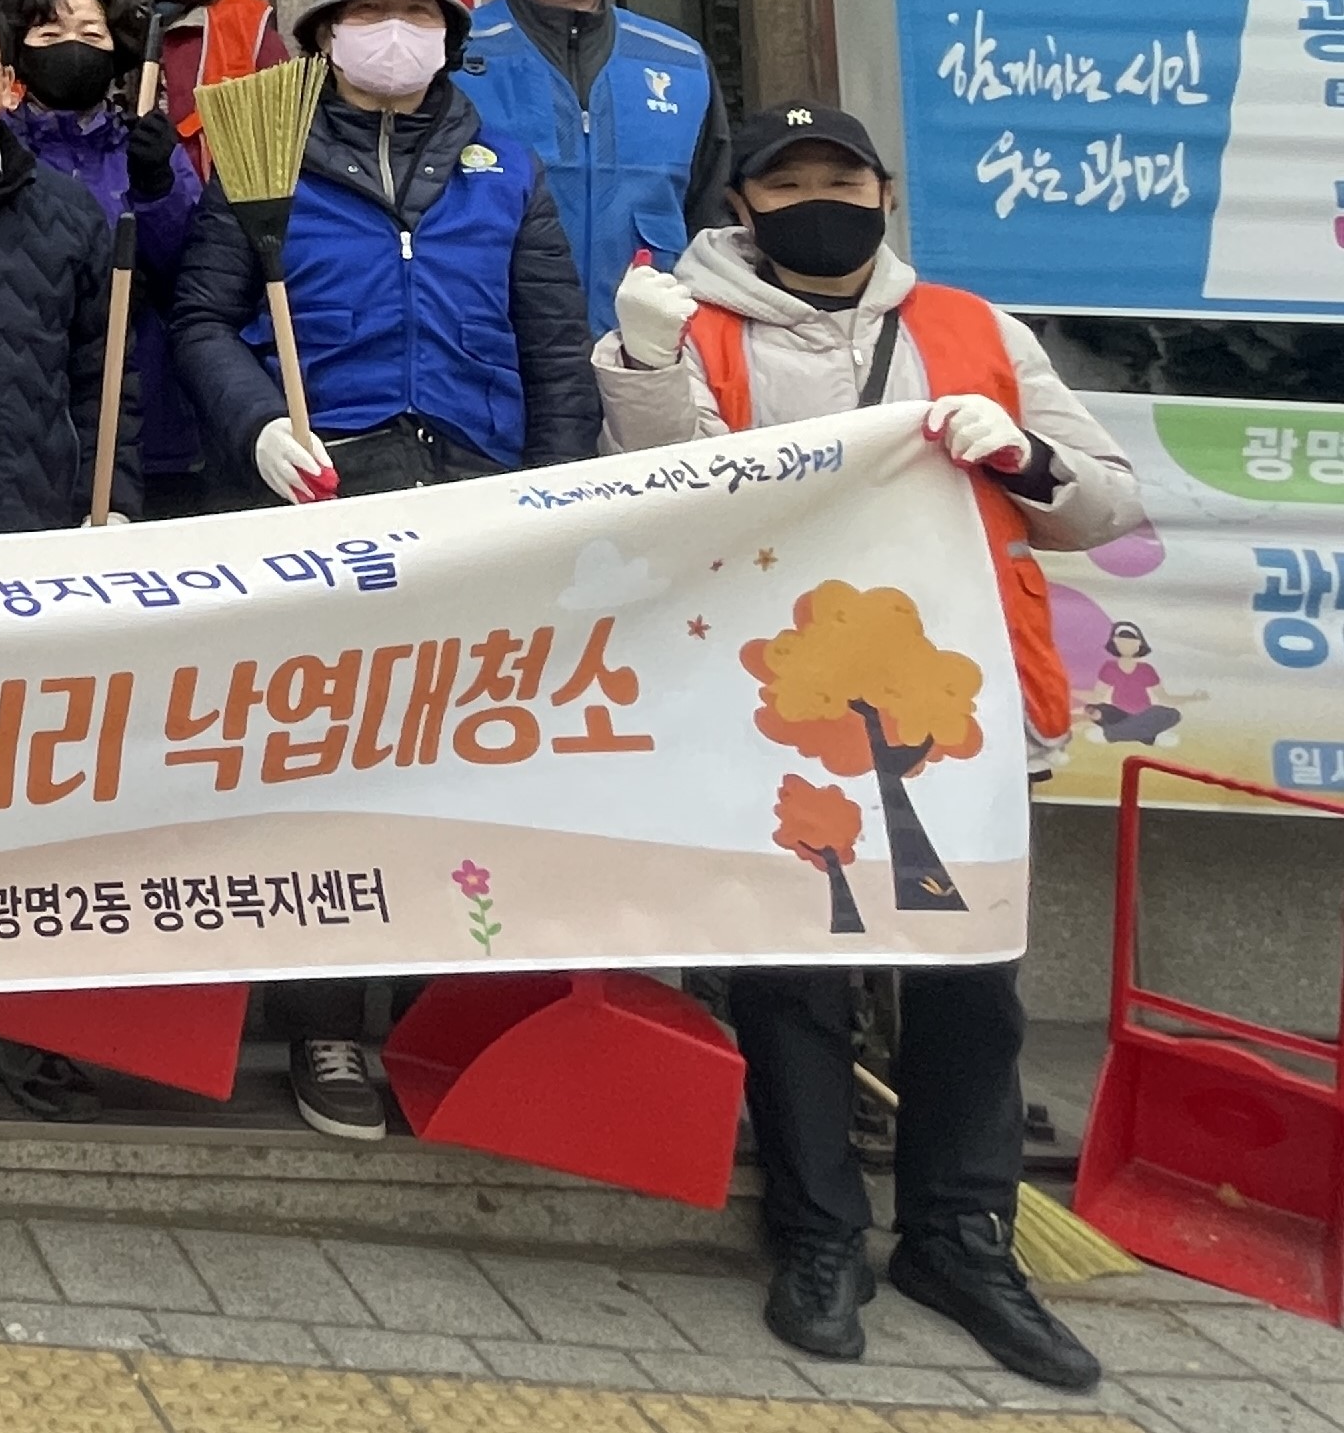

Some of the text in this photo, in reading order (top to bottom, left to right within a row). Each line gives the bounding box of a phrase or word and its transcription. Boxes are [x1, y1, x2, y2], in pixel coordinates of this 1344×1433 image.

[1115, 30, 1208, 105] 시민
[1075, 134, 1191, 212] 광명
[645, 460, 710, 493] 시민
[776, 439, 844, 481] 광명
[164, 616, 654, 793] 낙엽대청소
[139, 867, 391, 935] 행정복지센터
